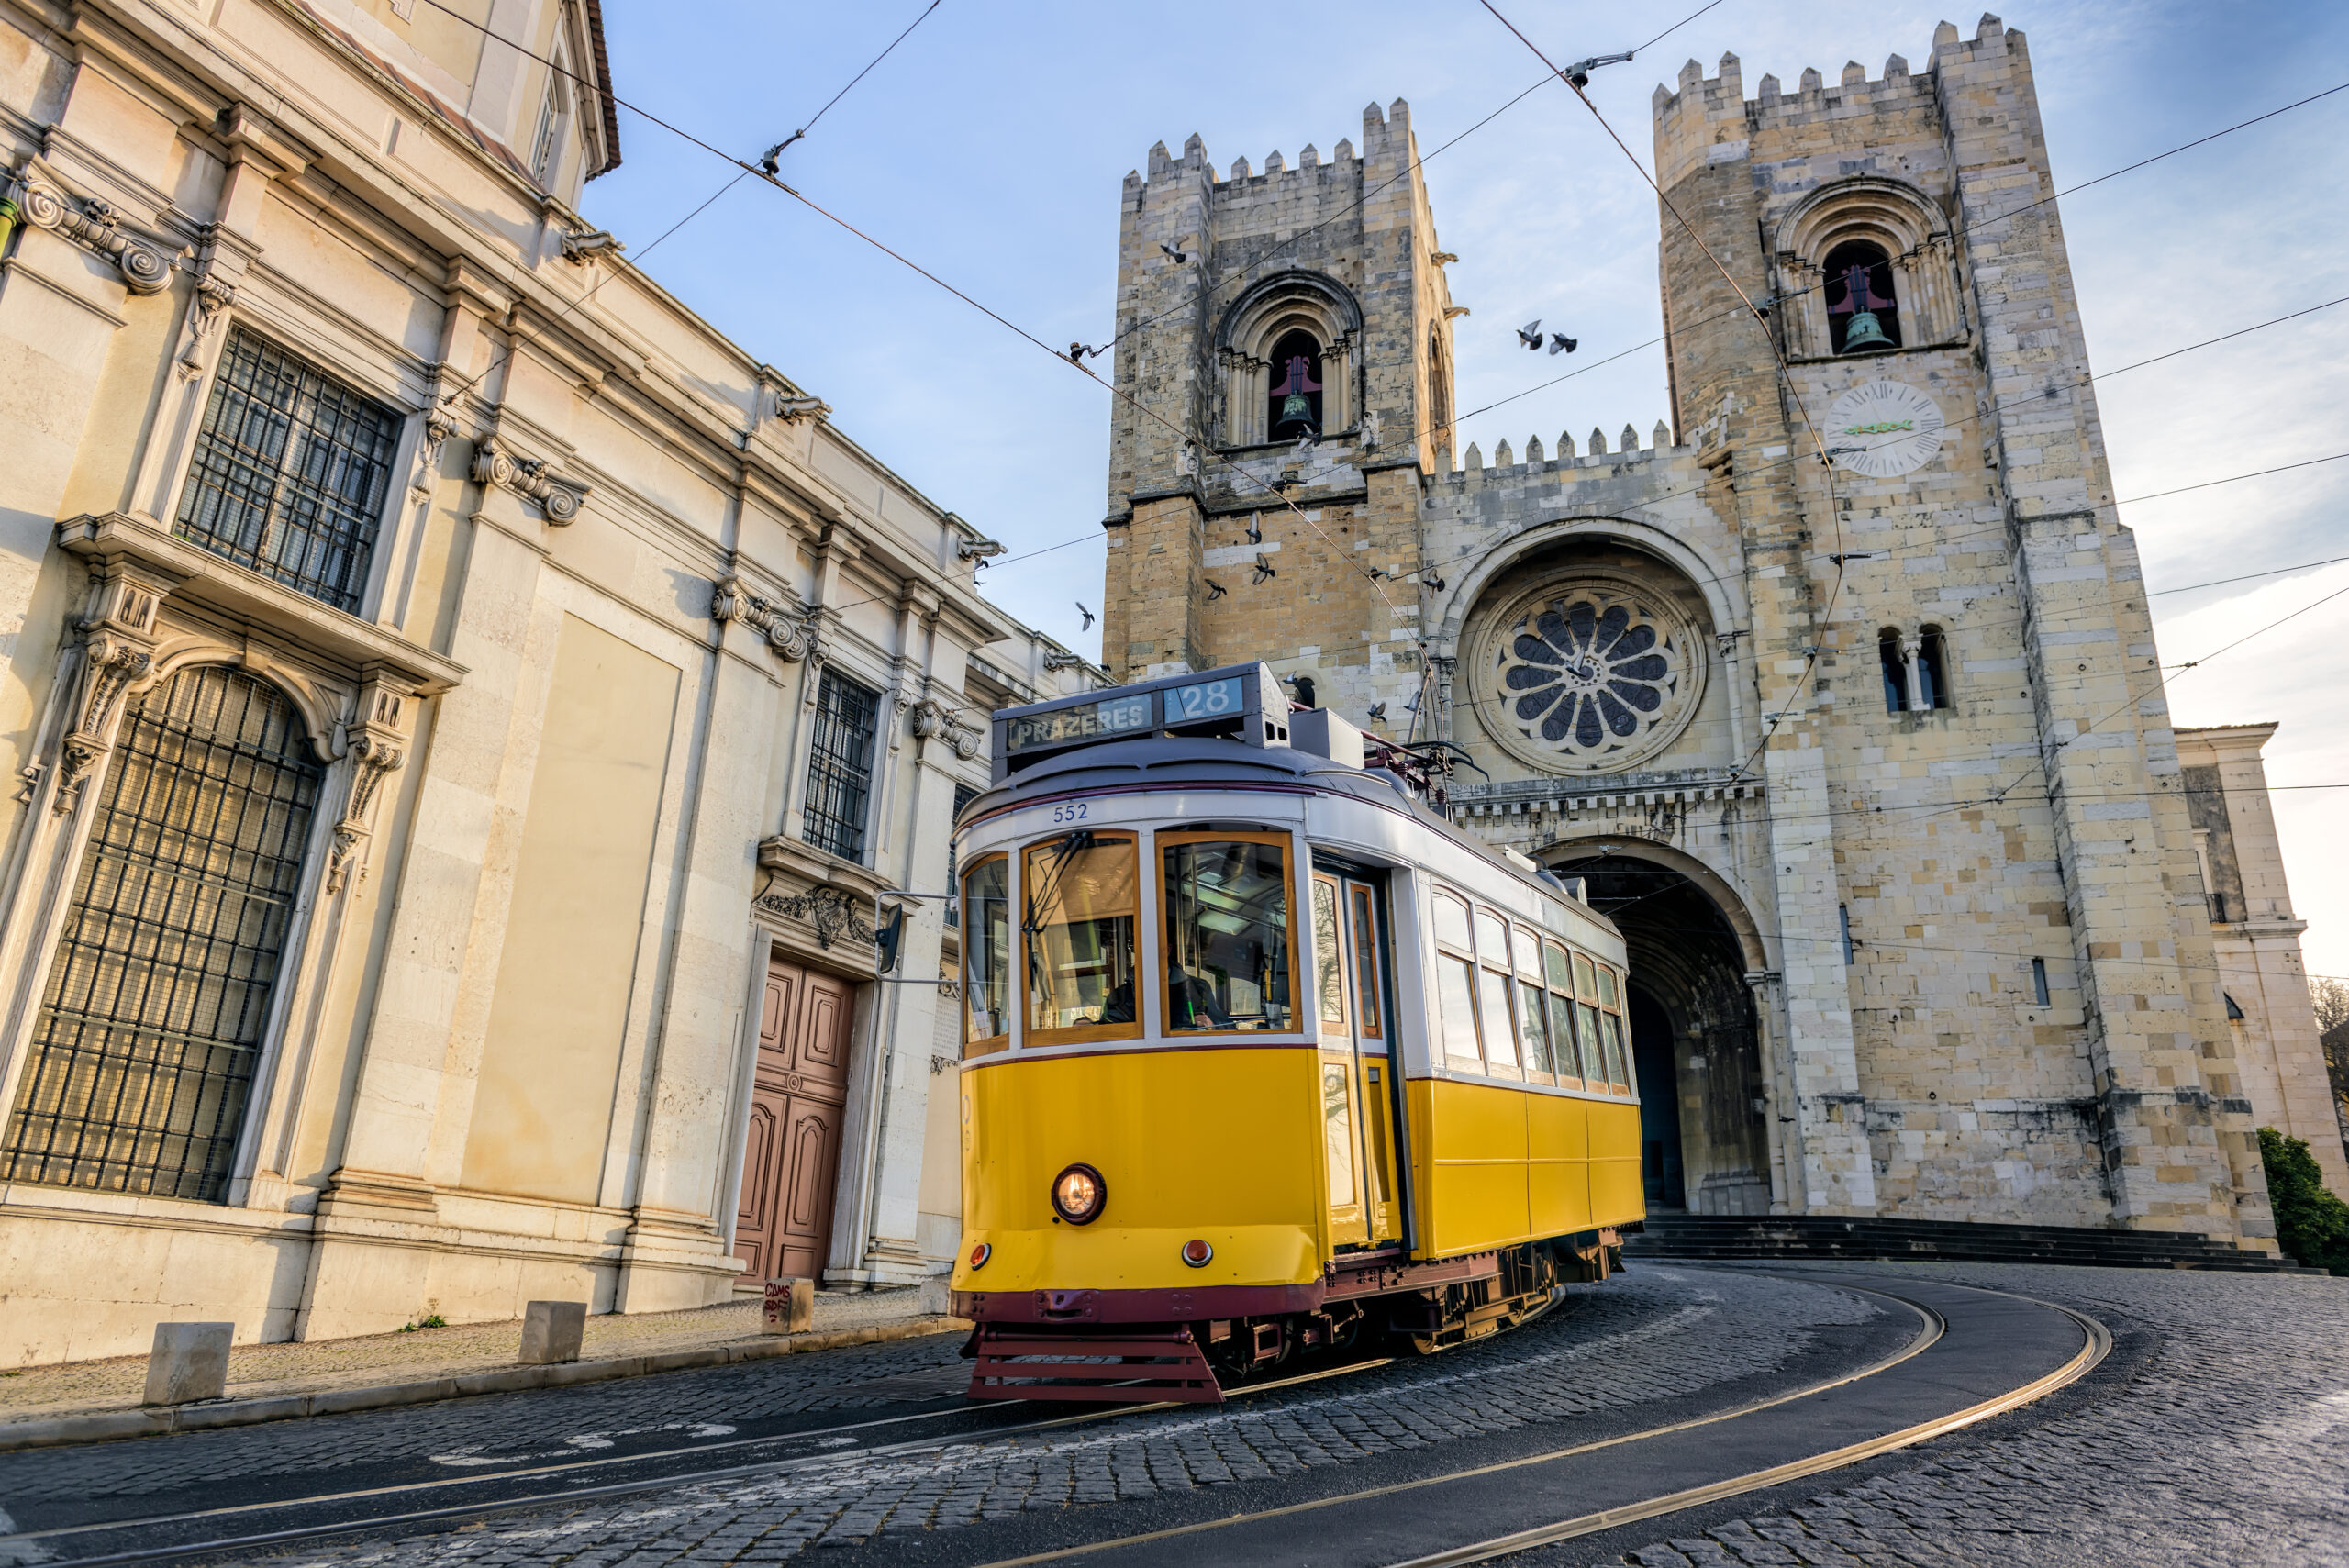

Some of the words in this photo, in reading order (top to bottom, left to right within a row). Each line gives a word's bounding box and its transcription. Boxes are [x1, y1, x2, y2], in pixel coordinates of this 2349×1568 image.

[1018, 705, 1143, 744] PRAZERES
[1182, 681, 1230, 718] 28
[1053, 803, 1087, 822] 552
